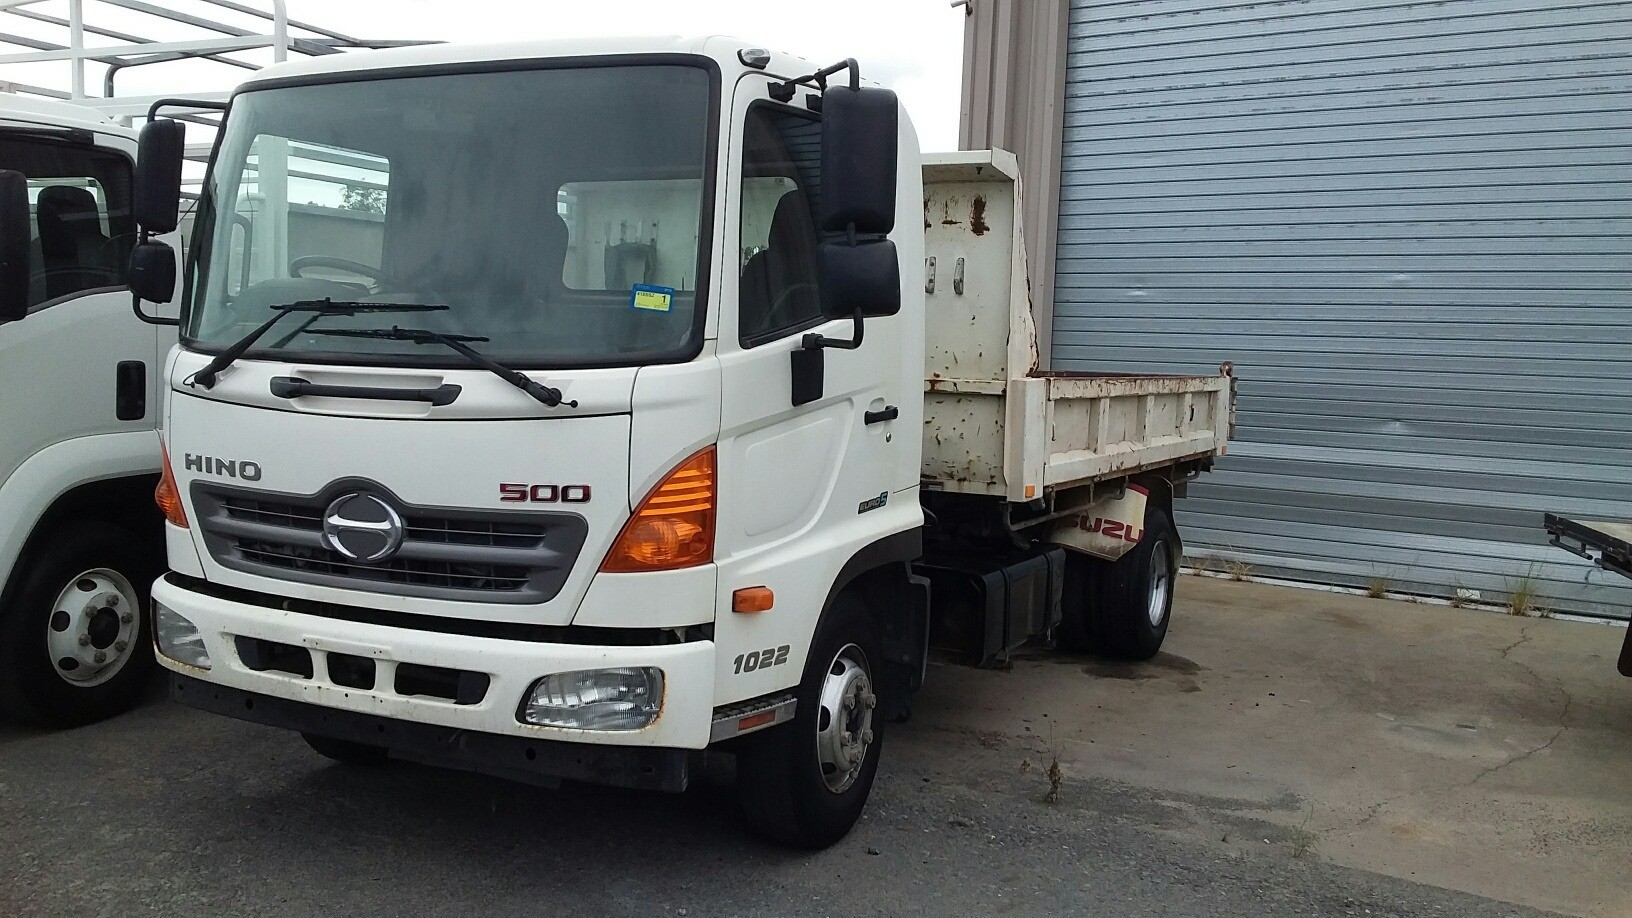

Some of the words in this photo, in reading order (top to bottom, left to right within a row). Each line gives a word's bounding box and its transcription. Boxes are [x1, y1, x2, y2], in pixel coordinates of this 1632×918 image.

[662, 294, 667, 304] 1
[185, 452, 262, 482] HINO
[499, 482, 592, 504] 500
[733, 644, 790, 675] 1022
